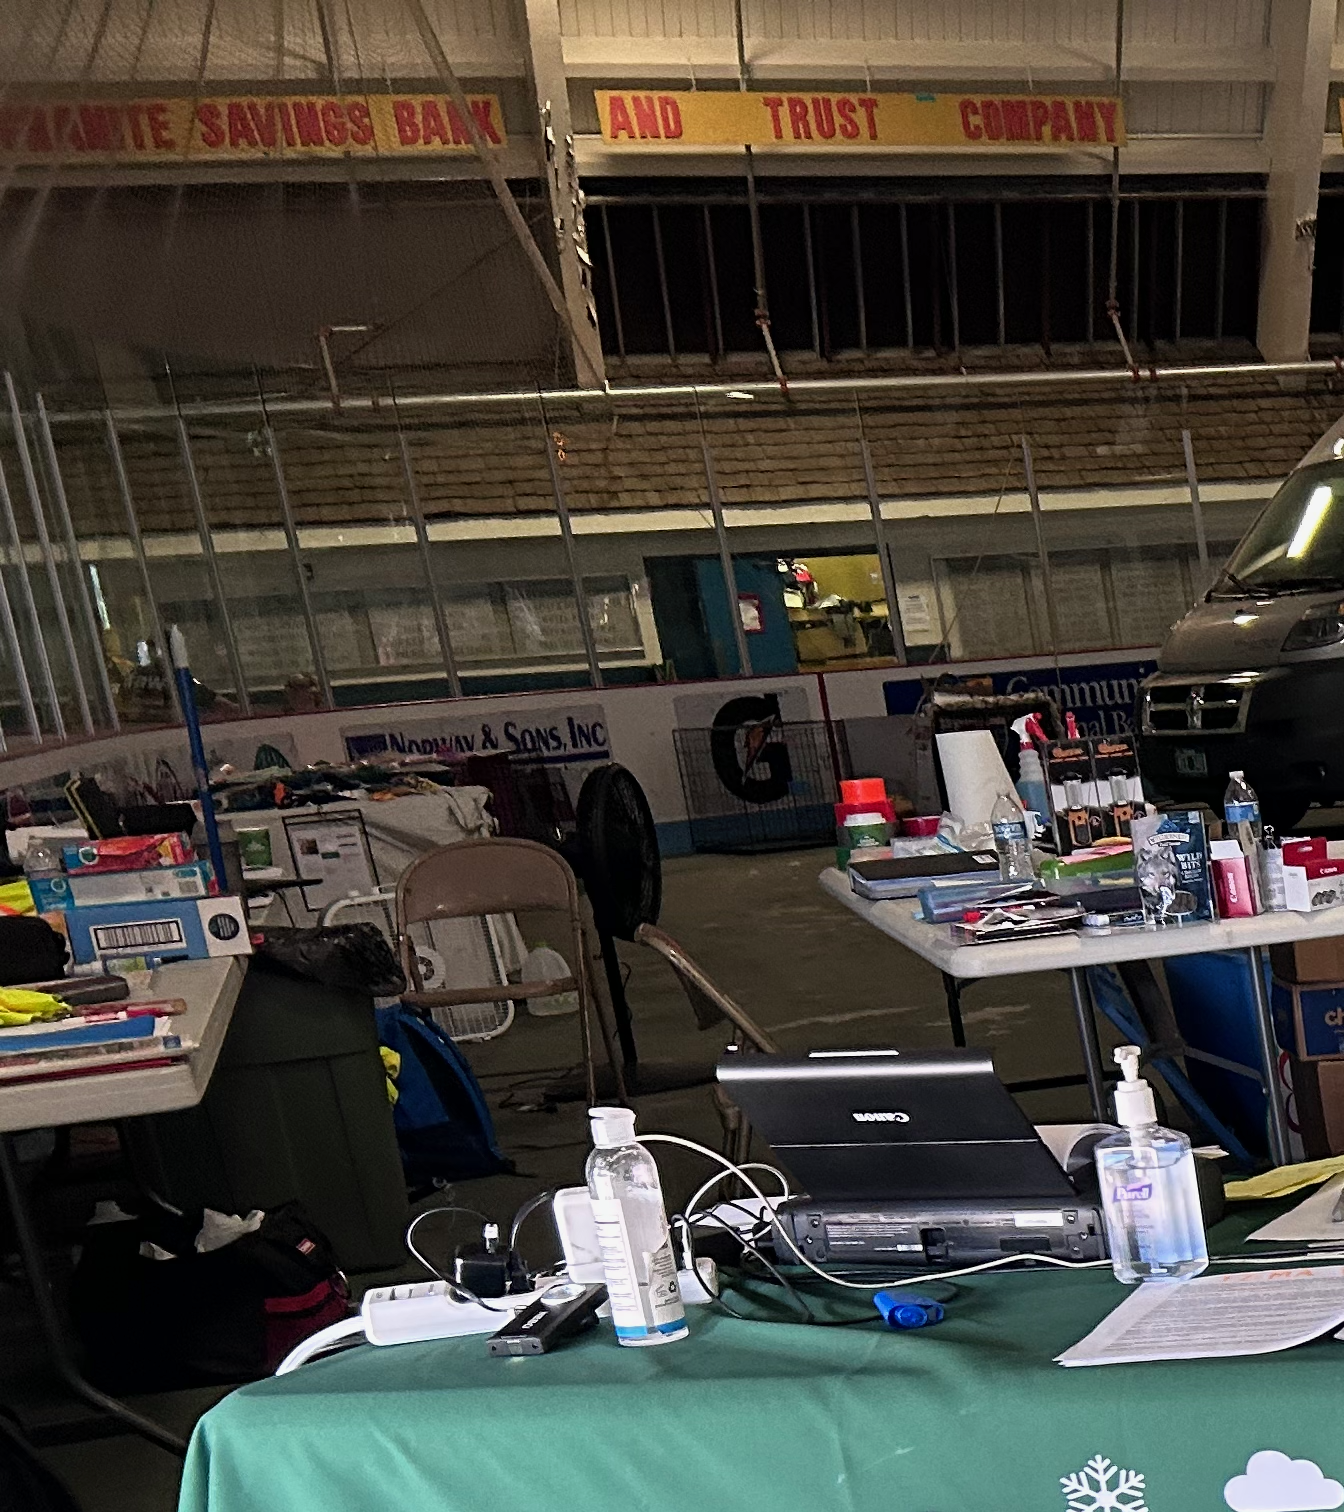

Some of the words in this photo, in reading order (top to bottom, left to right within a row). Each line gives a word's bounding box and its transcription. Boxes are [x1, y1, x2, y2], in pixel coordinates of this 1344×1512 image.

[195, 100, 374, 148] SAVINGS
[395, 98, 502, 147] BANK
[609, 95, 681, 140] AND
[762, 96, 879, 141] TRUST
[960, 99, 1118, 143] COMPANY
[481, 723, 499, 750] &
[567, 716, 607, 749] INC
[1176, 852, 1203, 862] WILD
[1181, 861, 1202, 870] BITS
[1228, 872, 1239, 903] Canon
[852, 1110, 912, 1124] Canon
[1116, 1186, 1150, 1201] Purell
